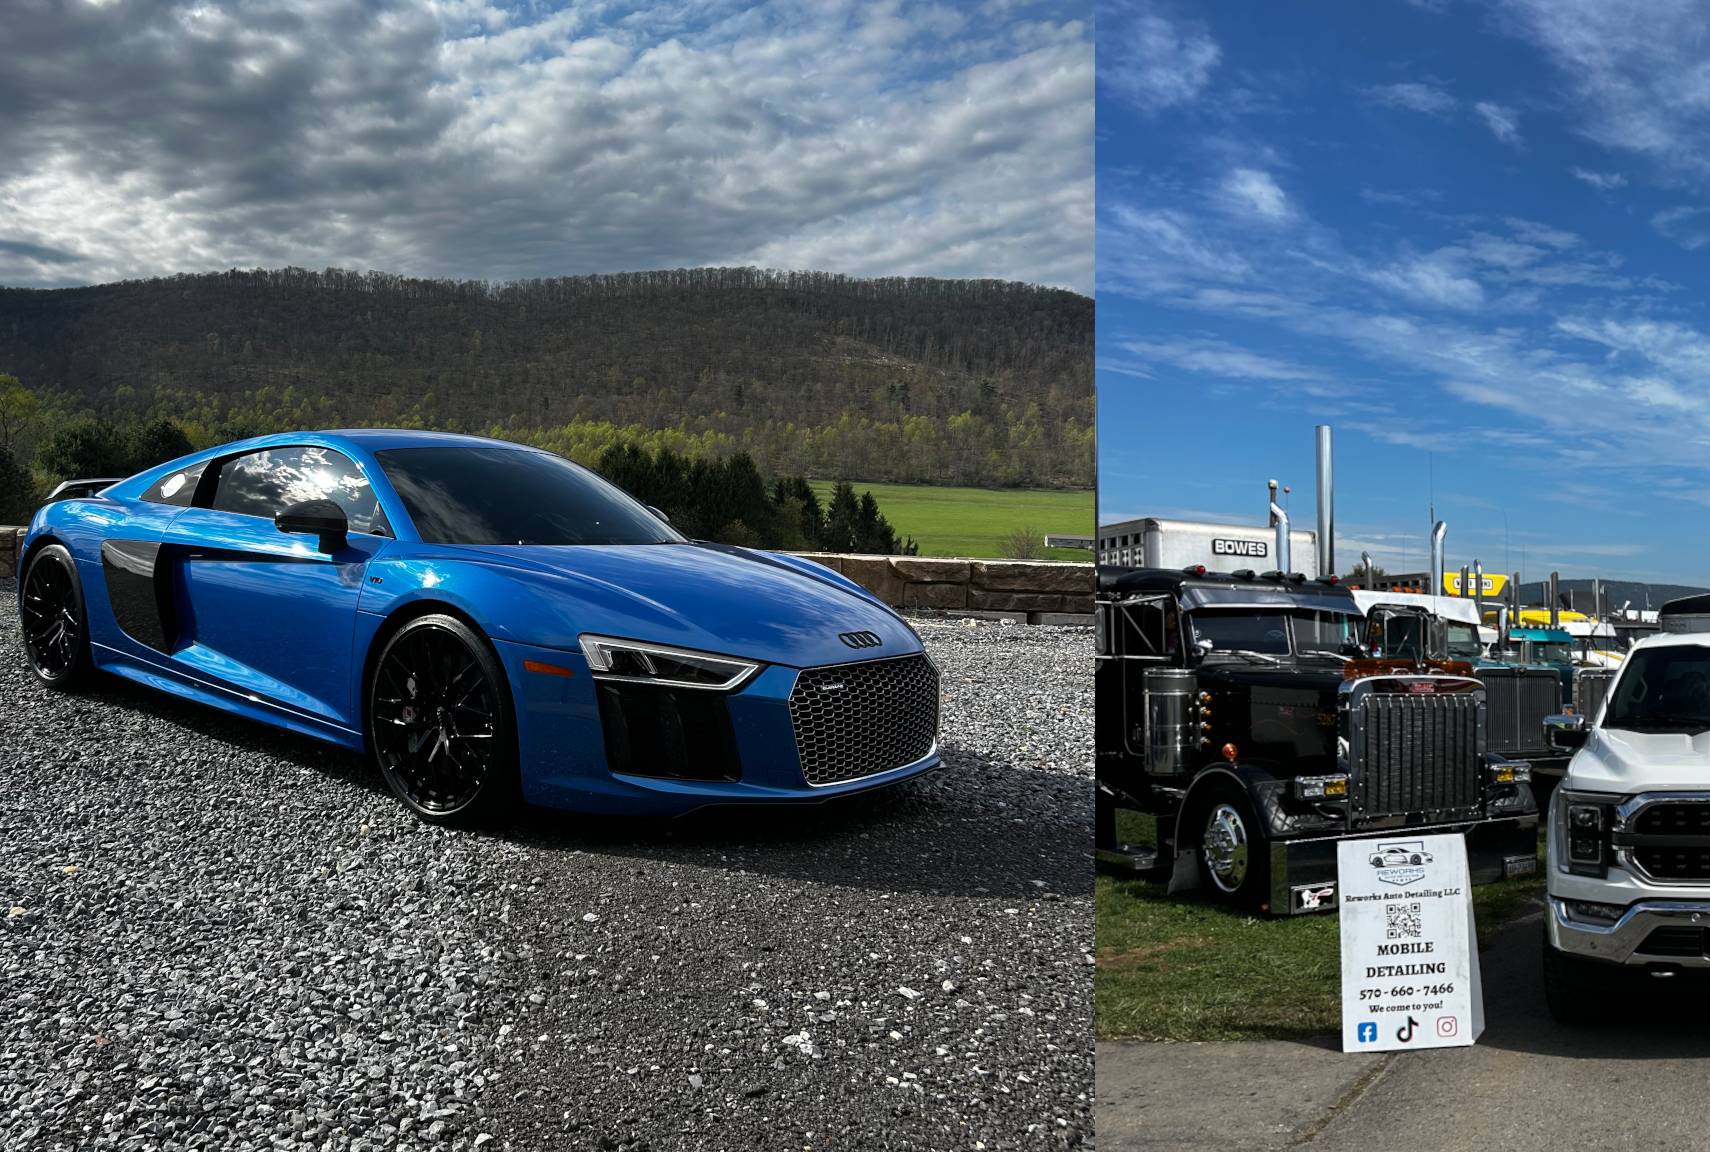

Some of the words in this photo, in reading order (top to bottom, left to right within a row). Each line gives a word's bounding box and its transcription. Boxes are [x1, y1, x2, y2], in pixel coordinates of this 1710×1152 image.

[1215, 540, 1266, 556] BOWES
[1345, 892, 1382, 903] Reworks
[1383, 892, 1403, 901] Auto
[1405, 889, 1443, 900] Detailing
[1444, 888, 1461, 897] LLC
[1377, 942, 1434, 956] MOBILE
[1366, 962, 1446, 978] DETAILING
[1369, 1004, 1385, 1013] We
[1386, 1003, 1411, 1012] come
[1423, 1000, 1444, 1012] you!
